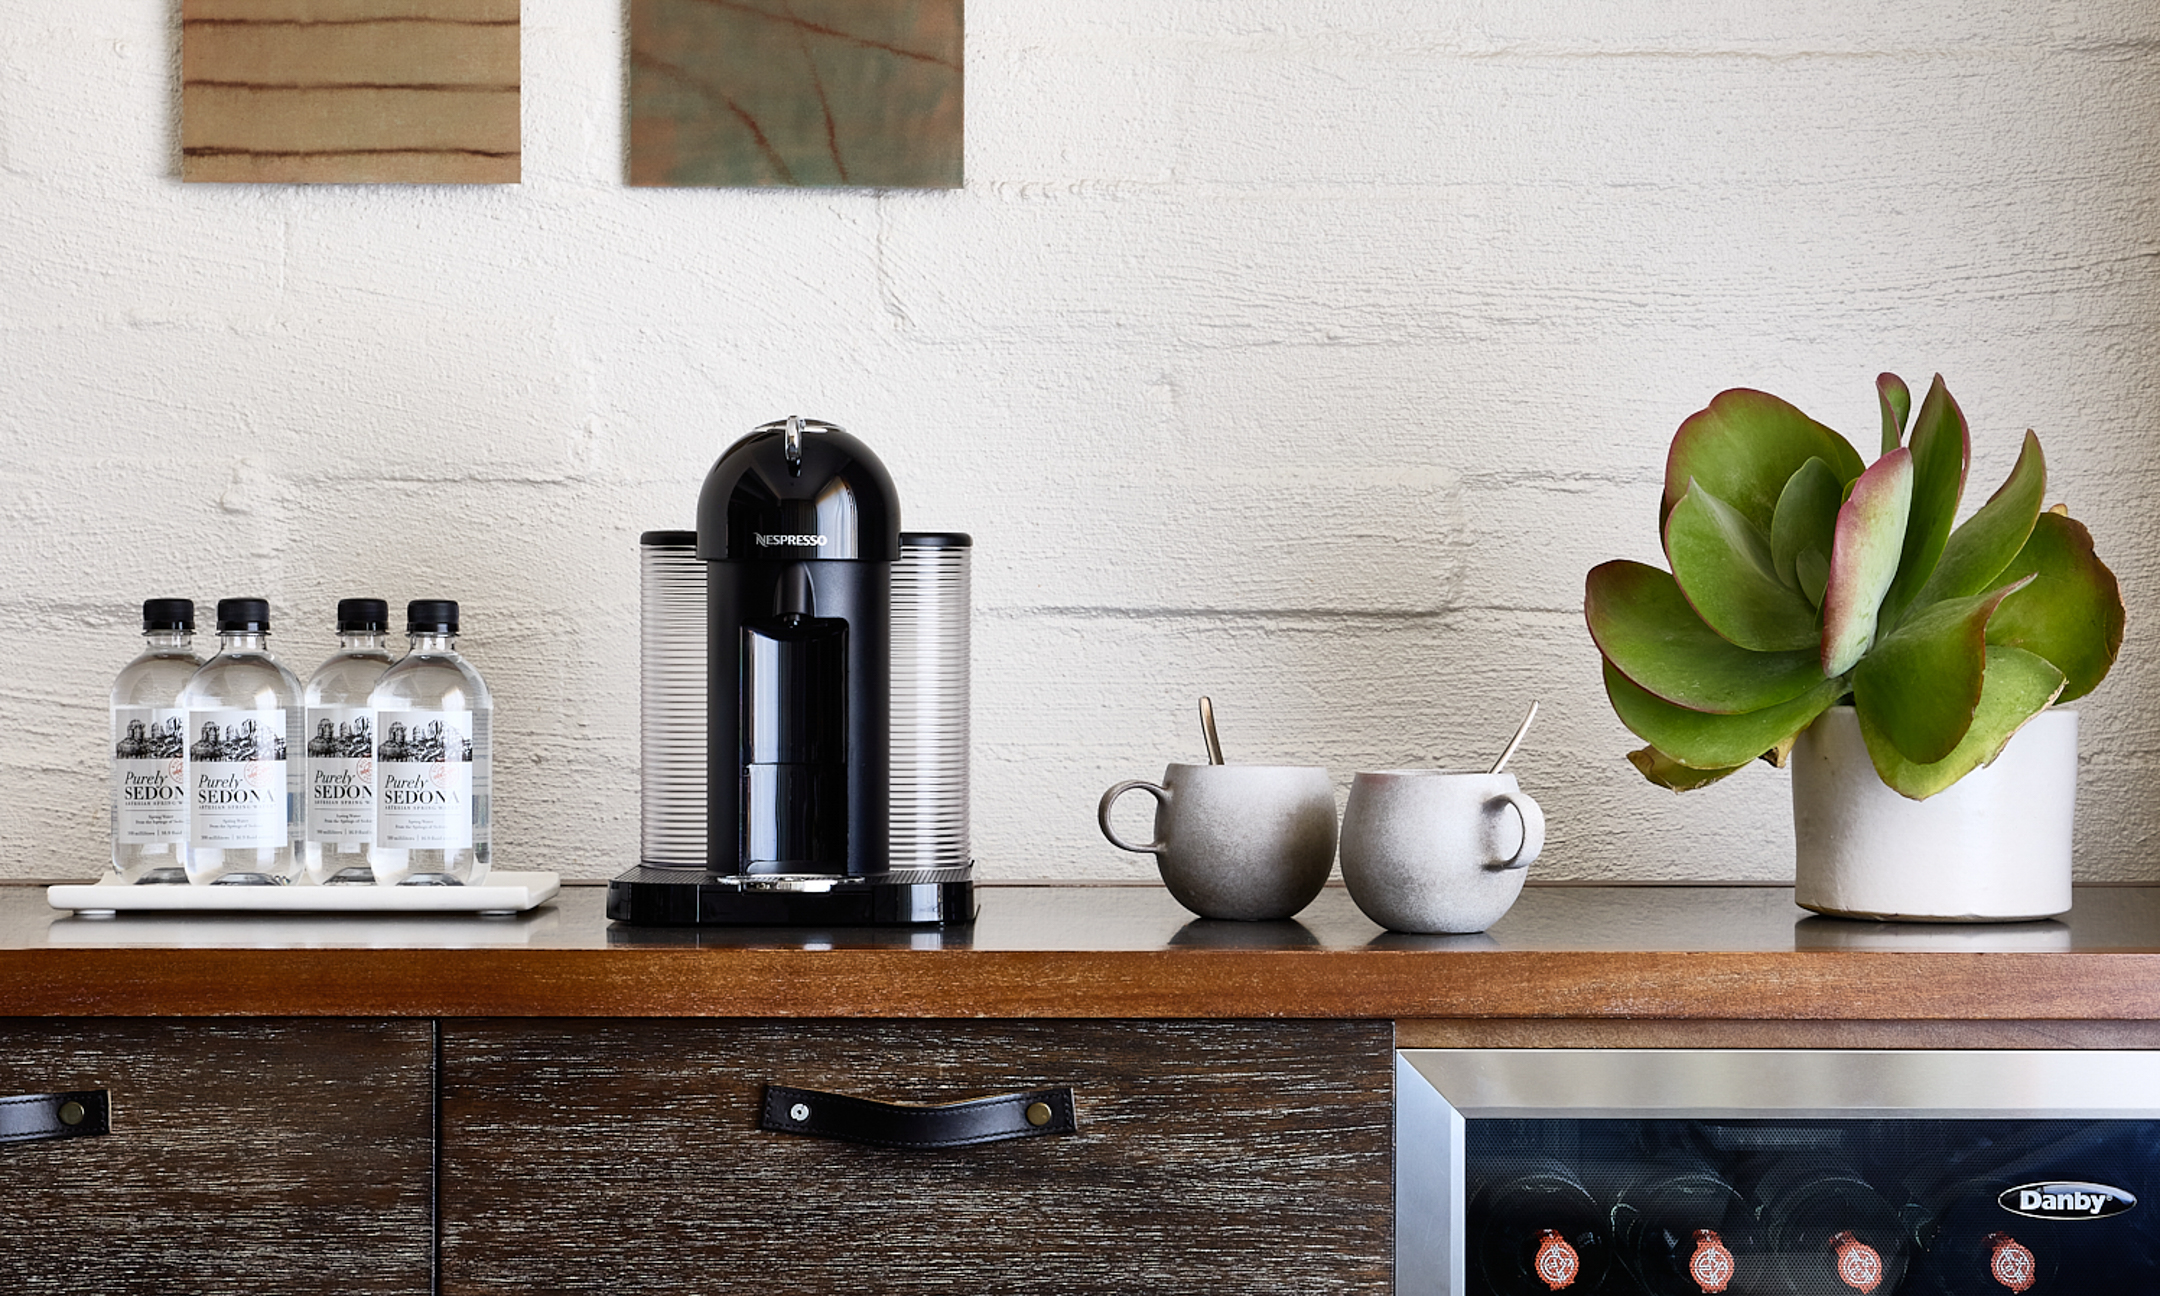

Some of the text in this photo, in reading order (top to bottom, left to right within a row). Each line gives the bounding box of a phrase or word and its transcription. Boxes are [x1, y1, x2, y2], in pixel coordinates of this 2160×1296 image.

[753, 532, 828, 548] NESPRESSO
[124, 770, 168, 788] Purely
[198, 773, 243, 791] Purely
[314, 769, 355, 787] Purely
[384, 774, 428, 791] Purely
[2019, 1190, 2106, 1215] Danby
